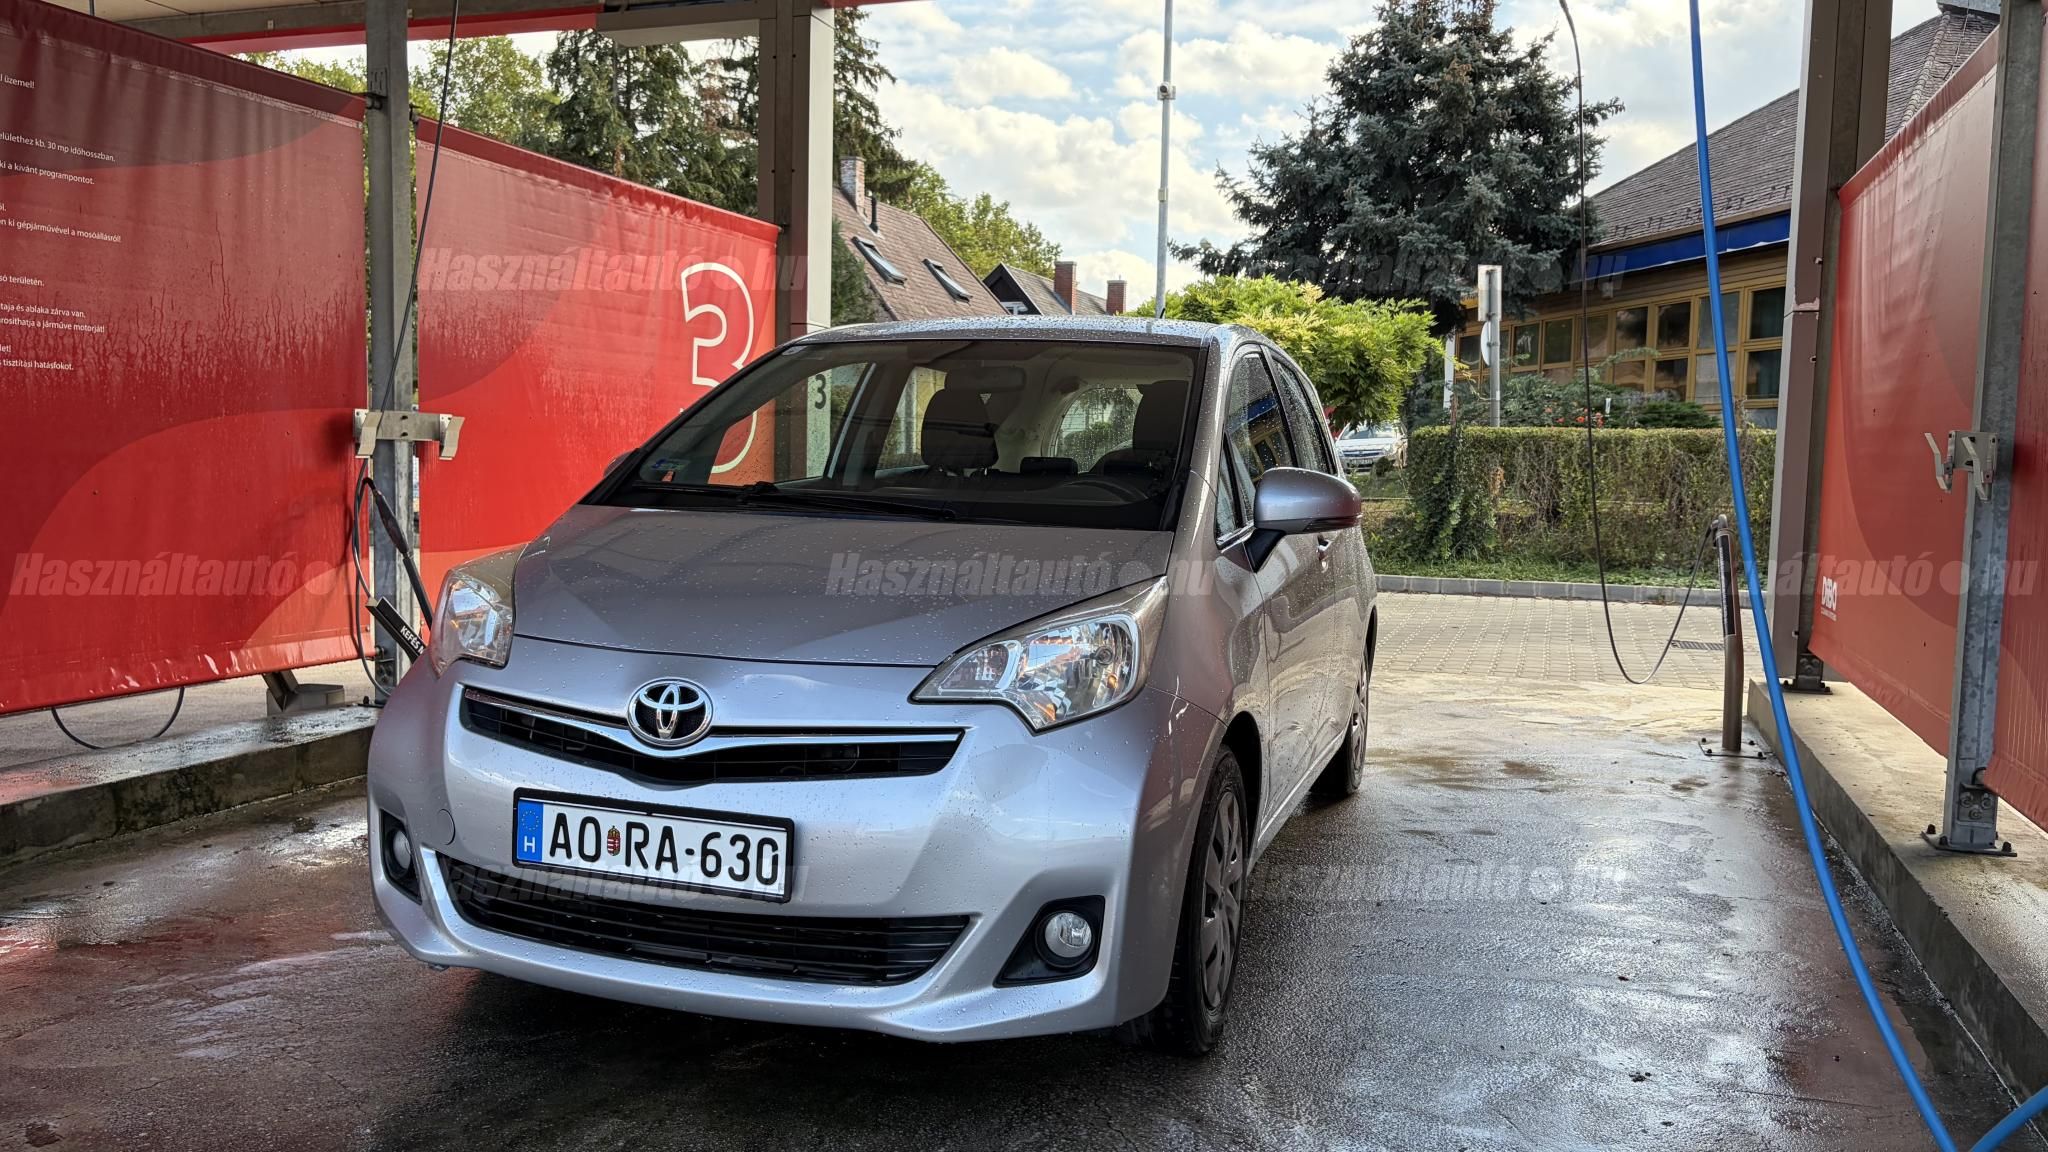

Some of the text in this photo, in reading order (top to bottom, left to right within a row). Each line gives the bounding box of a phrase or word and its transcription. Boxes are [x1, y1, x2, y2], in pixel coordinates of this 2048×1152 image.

[4, 74, 35, 89] üzemel!
[47, 141, 56, 150] 30
[57, 145, 69, 153] mp
[14, 162, 38, 175] kívánt
[39, 169, 95, 185] programpontot.
[8, 218, 15, 227] ki
[9, 275, 45, 287] területén.
[15, 304, 25, 312] és
[25, 304, 50, 314] ablaka
[50, 308, 70, 317] zárva
[0, 317, 35, 328] rosíthatja
[73, 324, 105, 334] motorját!
[3, 359, 33, 368] tisztítási
[34, 360, 74, 371] hatásfokot.
[814, 374, 827, 410] 3
[523, 836, 536, 854] H
